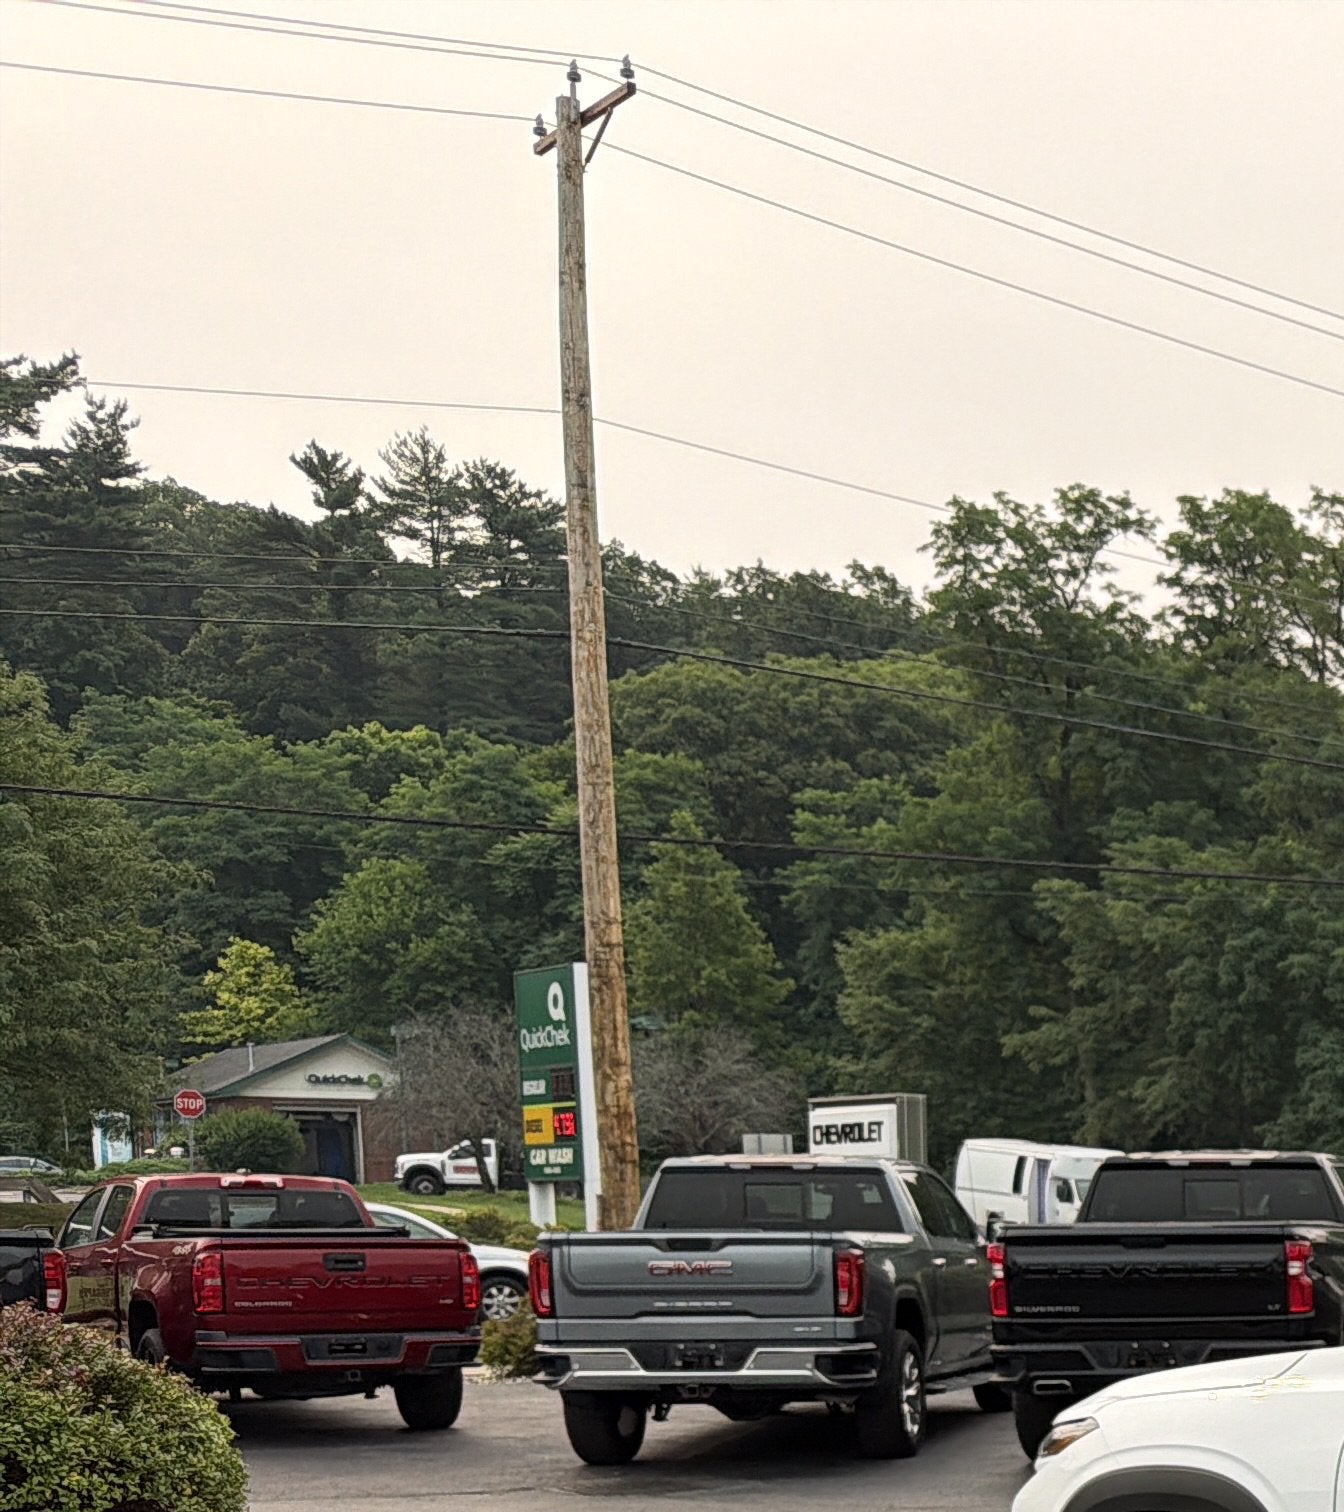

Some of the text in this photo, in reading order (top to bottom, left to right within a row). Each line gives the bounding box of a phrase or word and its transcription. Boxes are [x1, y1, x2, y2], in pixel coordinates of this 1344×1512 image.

[547, 981, 567, 1021] Q
[520, 1023, 571, 1052] QuickChek
[176, 1097, 203, 1110] STOP
[812, 1120, 885, 1146] CHEVROLET
[647, 1260, 734, 1276] GMC
[236, 1275, 450, 1290] CHEVROLET
